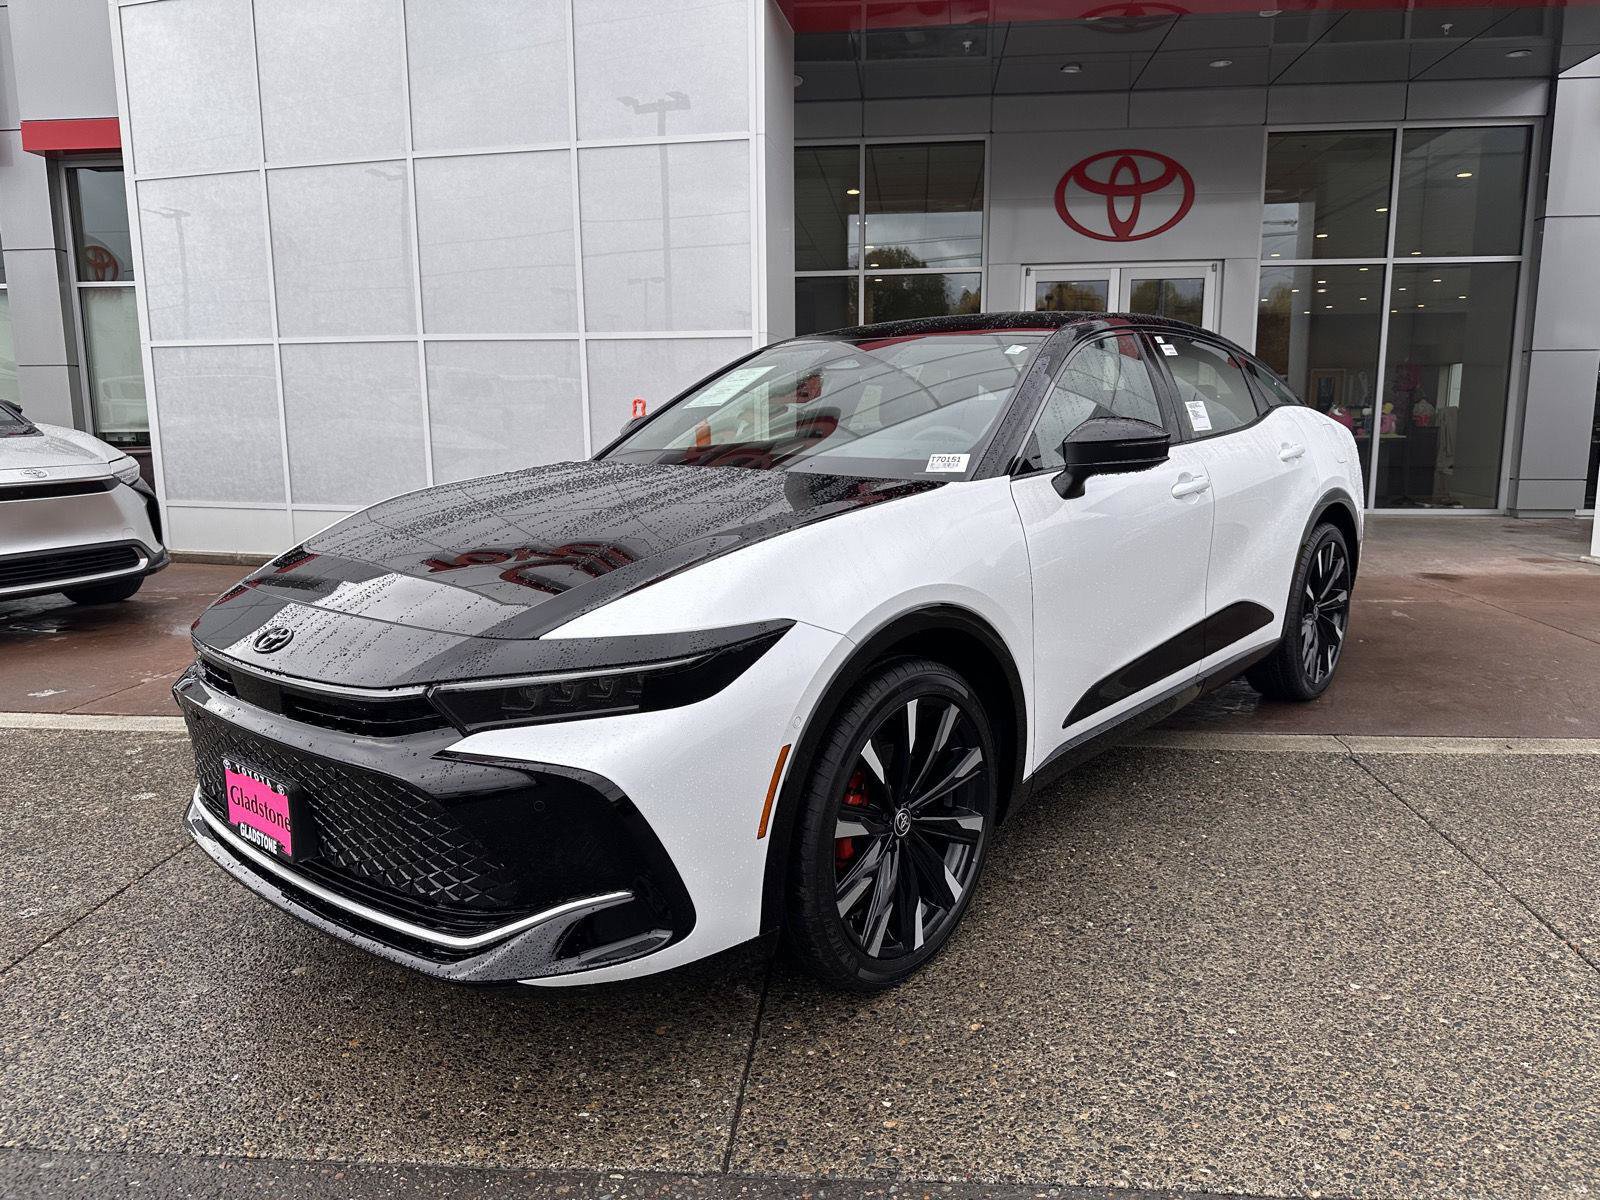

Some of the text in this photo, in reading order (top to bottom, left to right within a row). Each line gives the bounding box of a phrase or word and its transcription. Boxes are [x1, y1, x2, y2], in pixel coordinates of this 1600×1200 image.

[236, 763, 272, 788] TOYOTA
[230, 785, 292, 832] Gladstone
[239, 822, 277, 854] GLADSTONE
